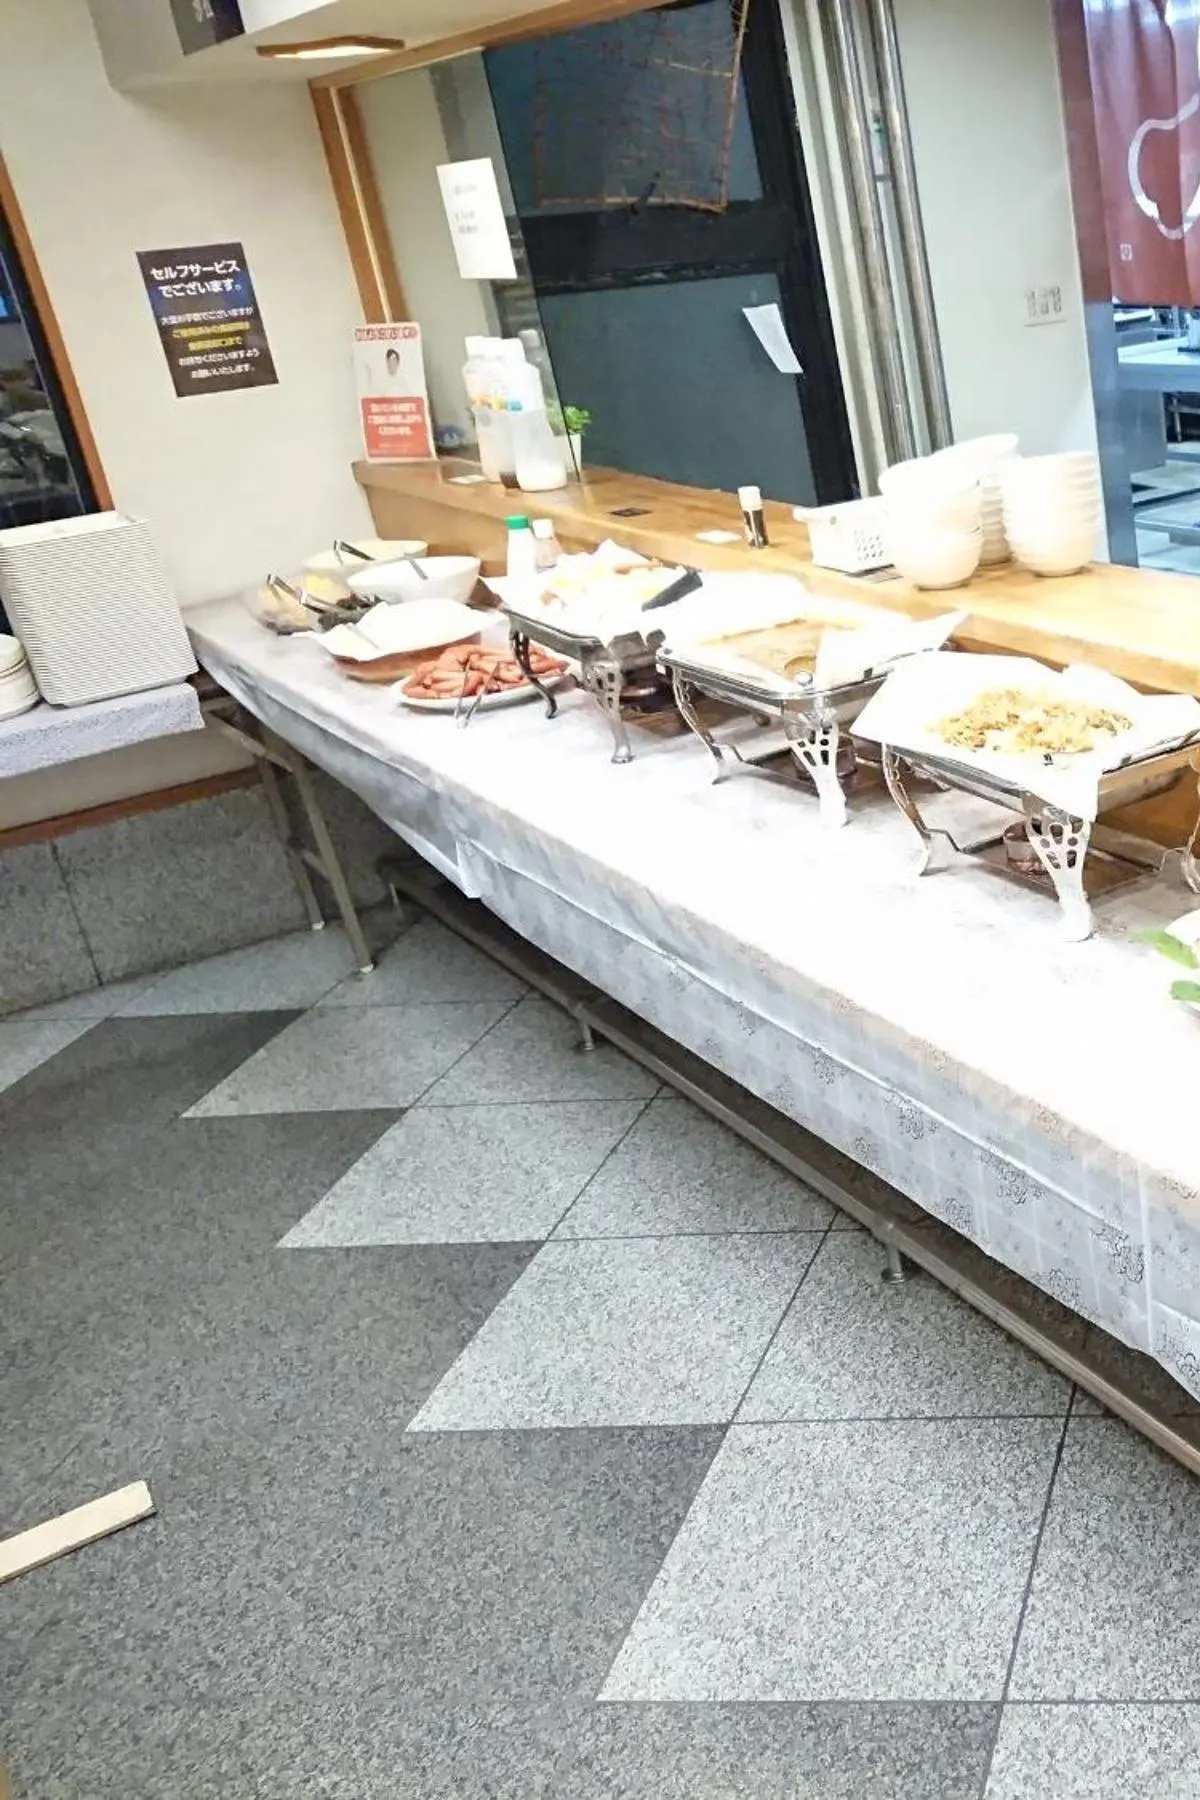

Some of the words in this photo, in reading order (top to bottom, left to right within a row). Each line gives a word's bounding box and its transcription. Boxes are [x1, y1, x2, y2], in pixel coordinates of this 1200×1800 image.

[151, 259, 241, 281] セルフサービス
[158, 278, 242, 298] でございます。
